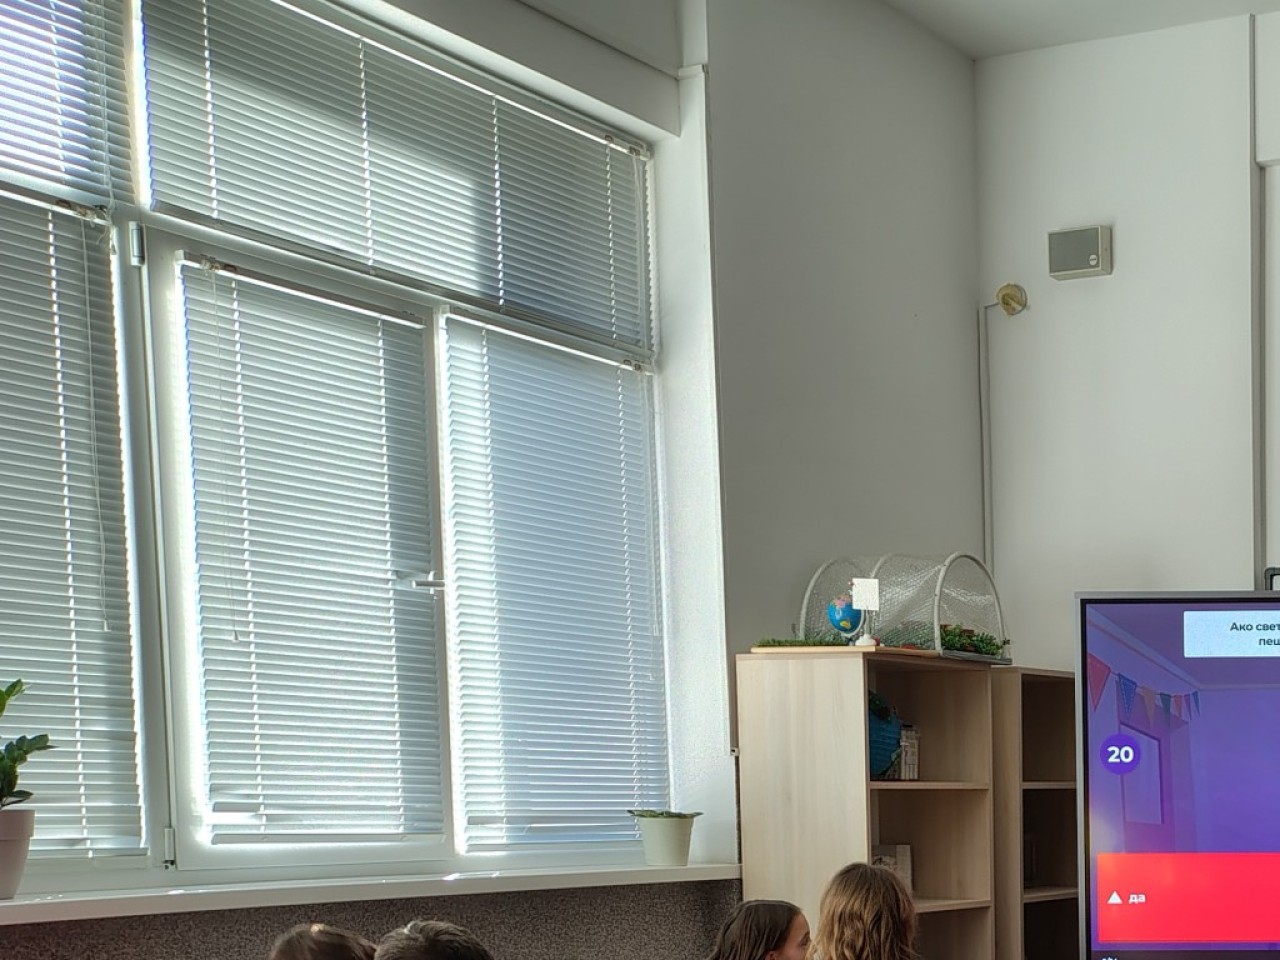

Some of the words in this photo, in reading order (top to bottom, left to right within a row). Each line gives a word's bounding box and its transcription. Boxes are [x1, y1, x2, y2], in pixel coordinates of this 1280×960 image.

[1230, 621, 1253, 632] Ако
[1107, 745, 1134, 763] 20
[1128, 894, 1146, 904] да
